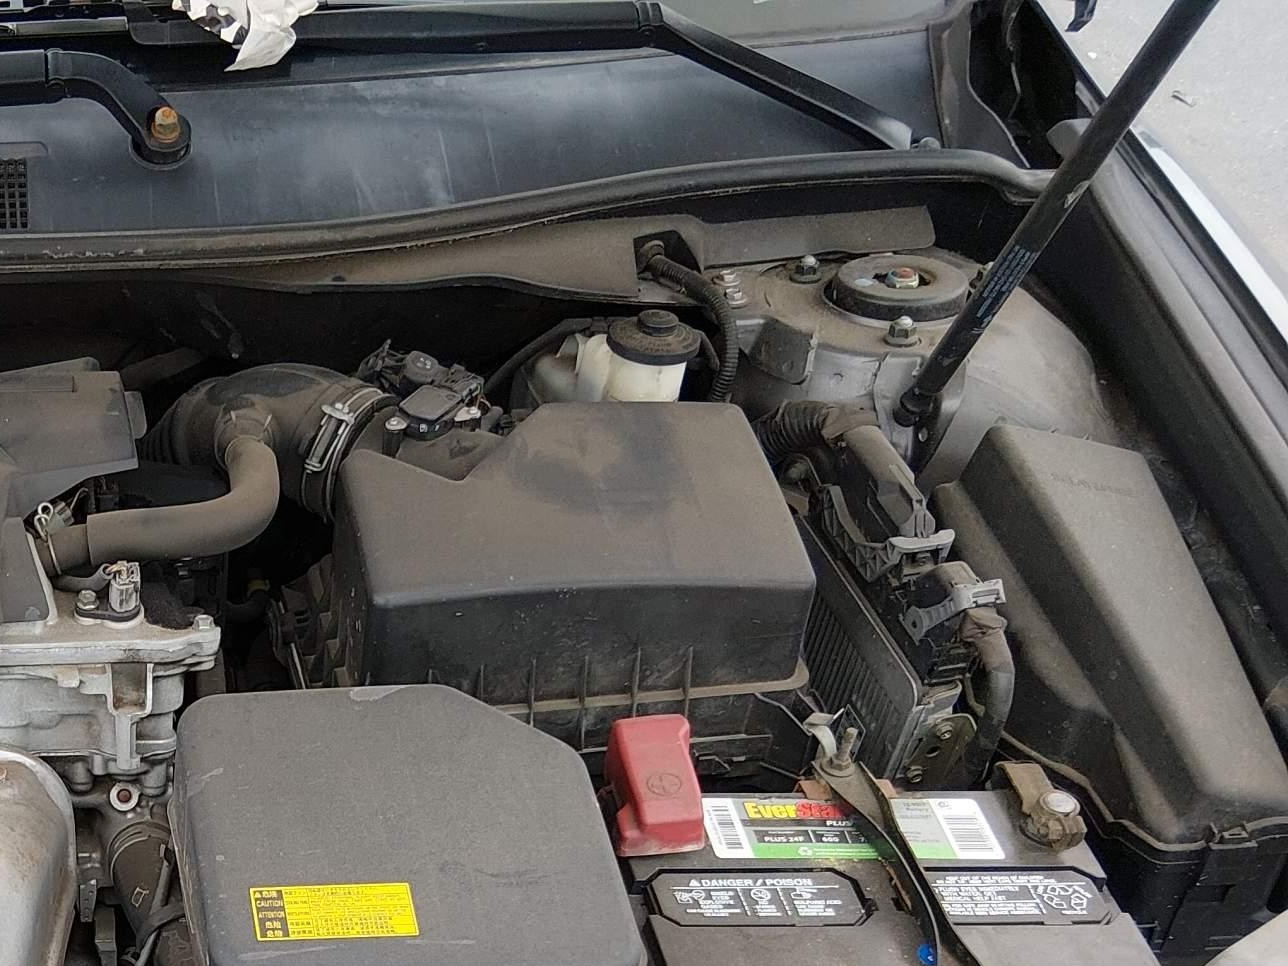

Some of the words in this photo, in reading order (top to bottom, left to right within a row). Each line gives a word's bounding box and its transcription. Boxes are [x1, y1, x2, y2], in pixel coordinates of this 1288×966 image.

[743, 801, 843, 818] EverSta
[701, 879, 754, 887] DANGER
[256, 900, 283, 908] CAUTION
